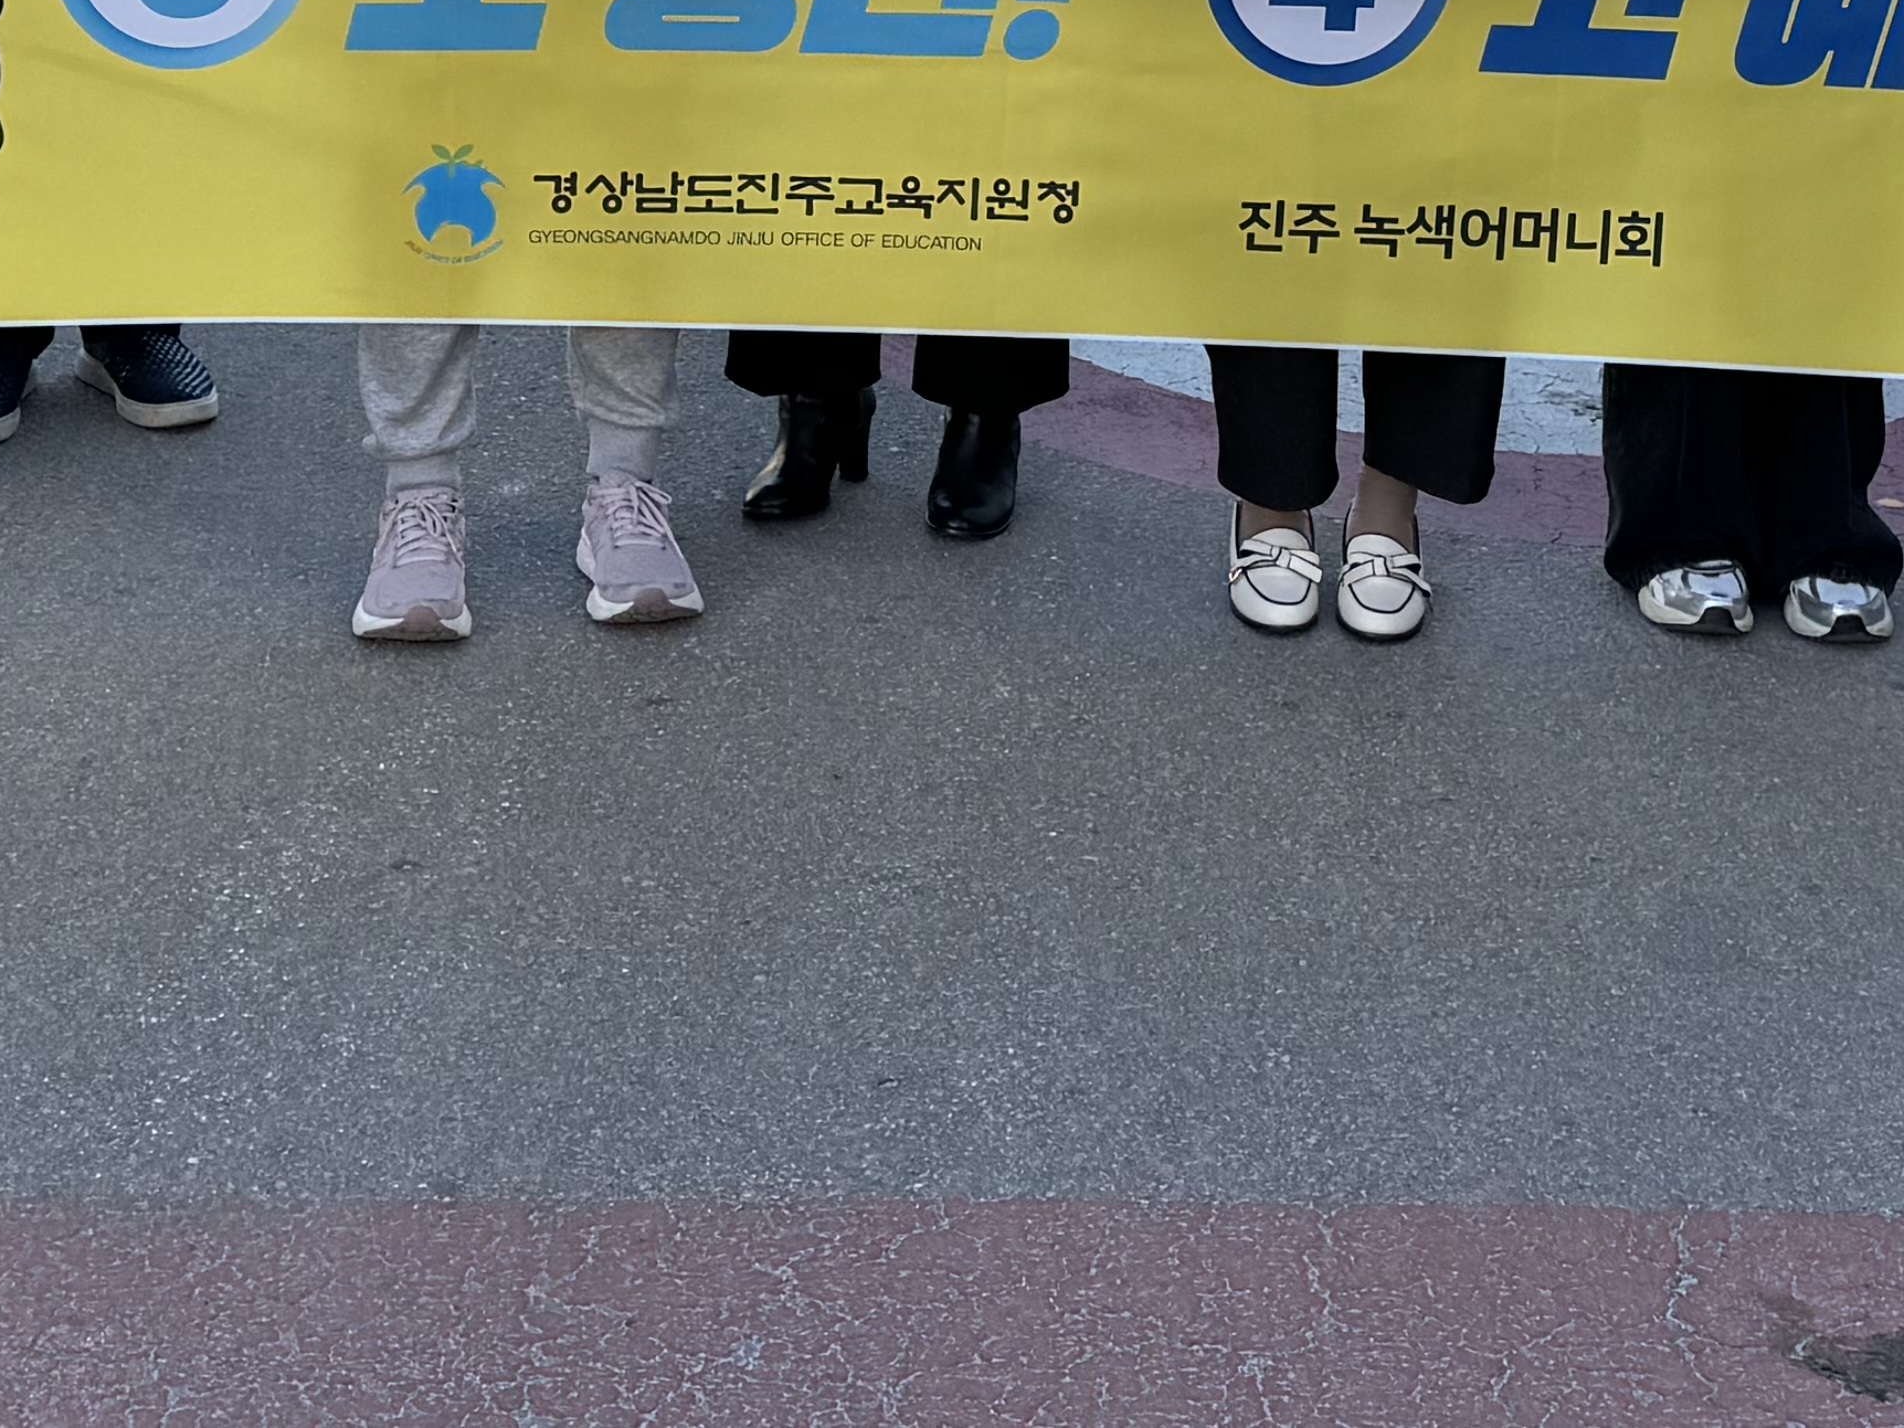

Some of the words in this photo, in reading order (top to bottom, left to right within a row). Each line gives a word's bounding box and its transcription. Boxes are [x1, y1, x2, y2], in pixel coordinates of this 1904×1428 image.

[533, 171, 1080, 224] 경상남도진주교육지원청
[528, 229, 721, 246] GYEONGSANGNAMDO
[726, 230, 775, 246] JINJU
[780, 231, 845, 248] OFFICE
[850, 233, 875, 248] OF
[881, 233, 982, 251] EDUCATION
[1238, 200, 1340, 254] 진주
[1354, 204, 1664, 267] 녹색어머니회
